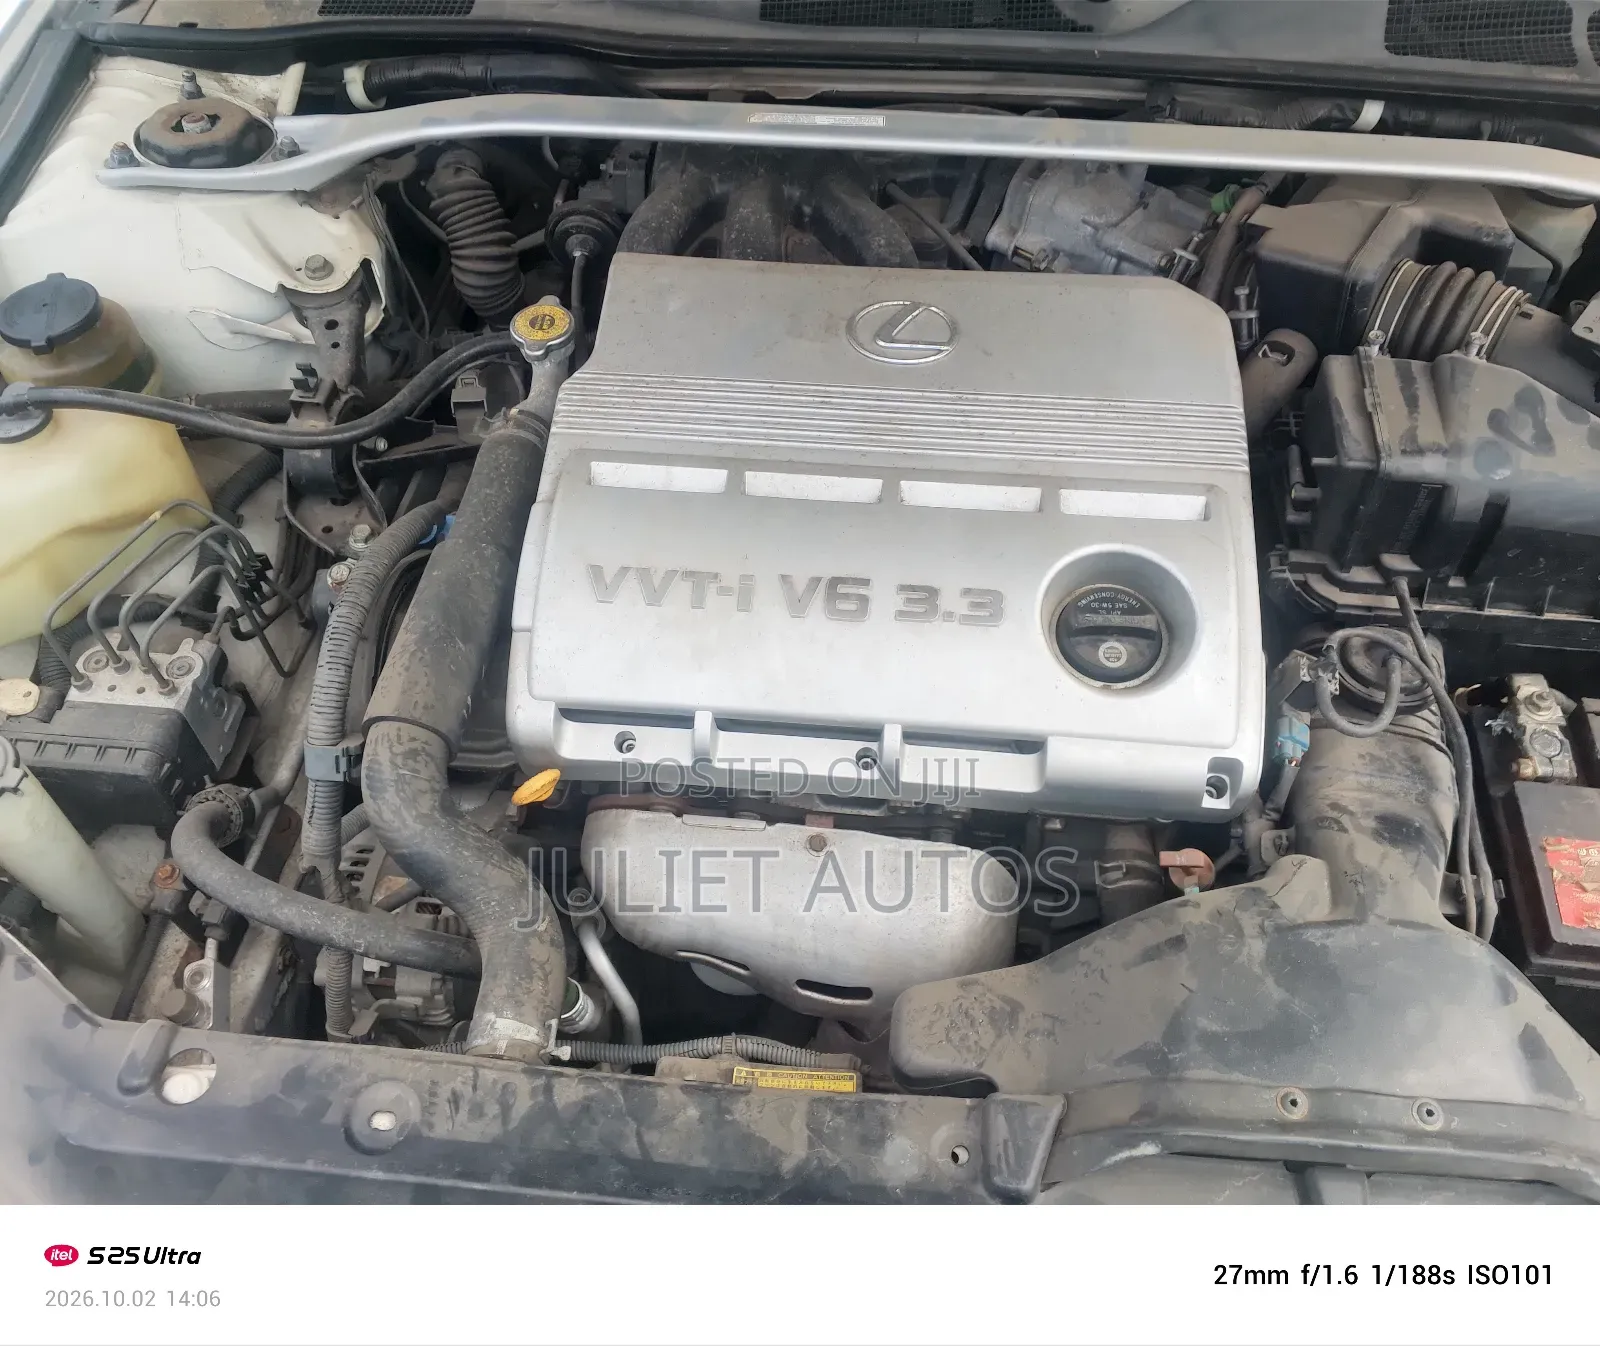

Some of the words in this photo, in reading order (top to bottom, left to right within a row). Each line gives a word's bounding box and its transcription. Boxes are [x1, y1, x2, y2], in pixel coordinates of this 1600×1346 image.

[587, 563, 756, 613] VVT-i
[778, 572, 874, 623] V6
[894, 582, 1008, 629] 3.3
[1077, 591, 1115, 608] CONSERVING
[1115, 592, 1141, 608] ENERGY
